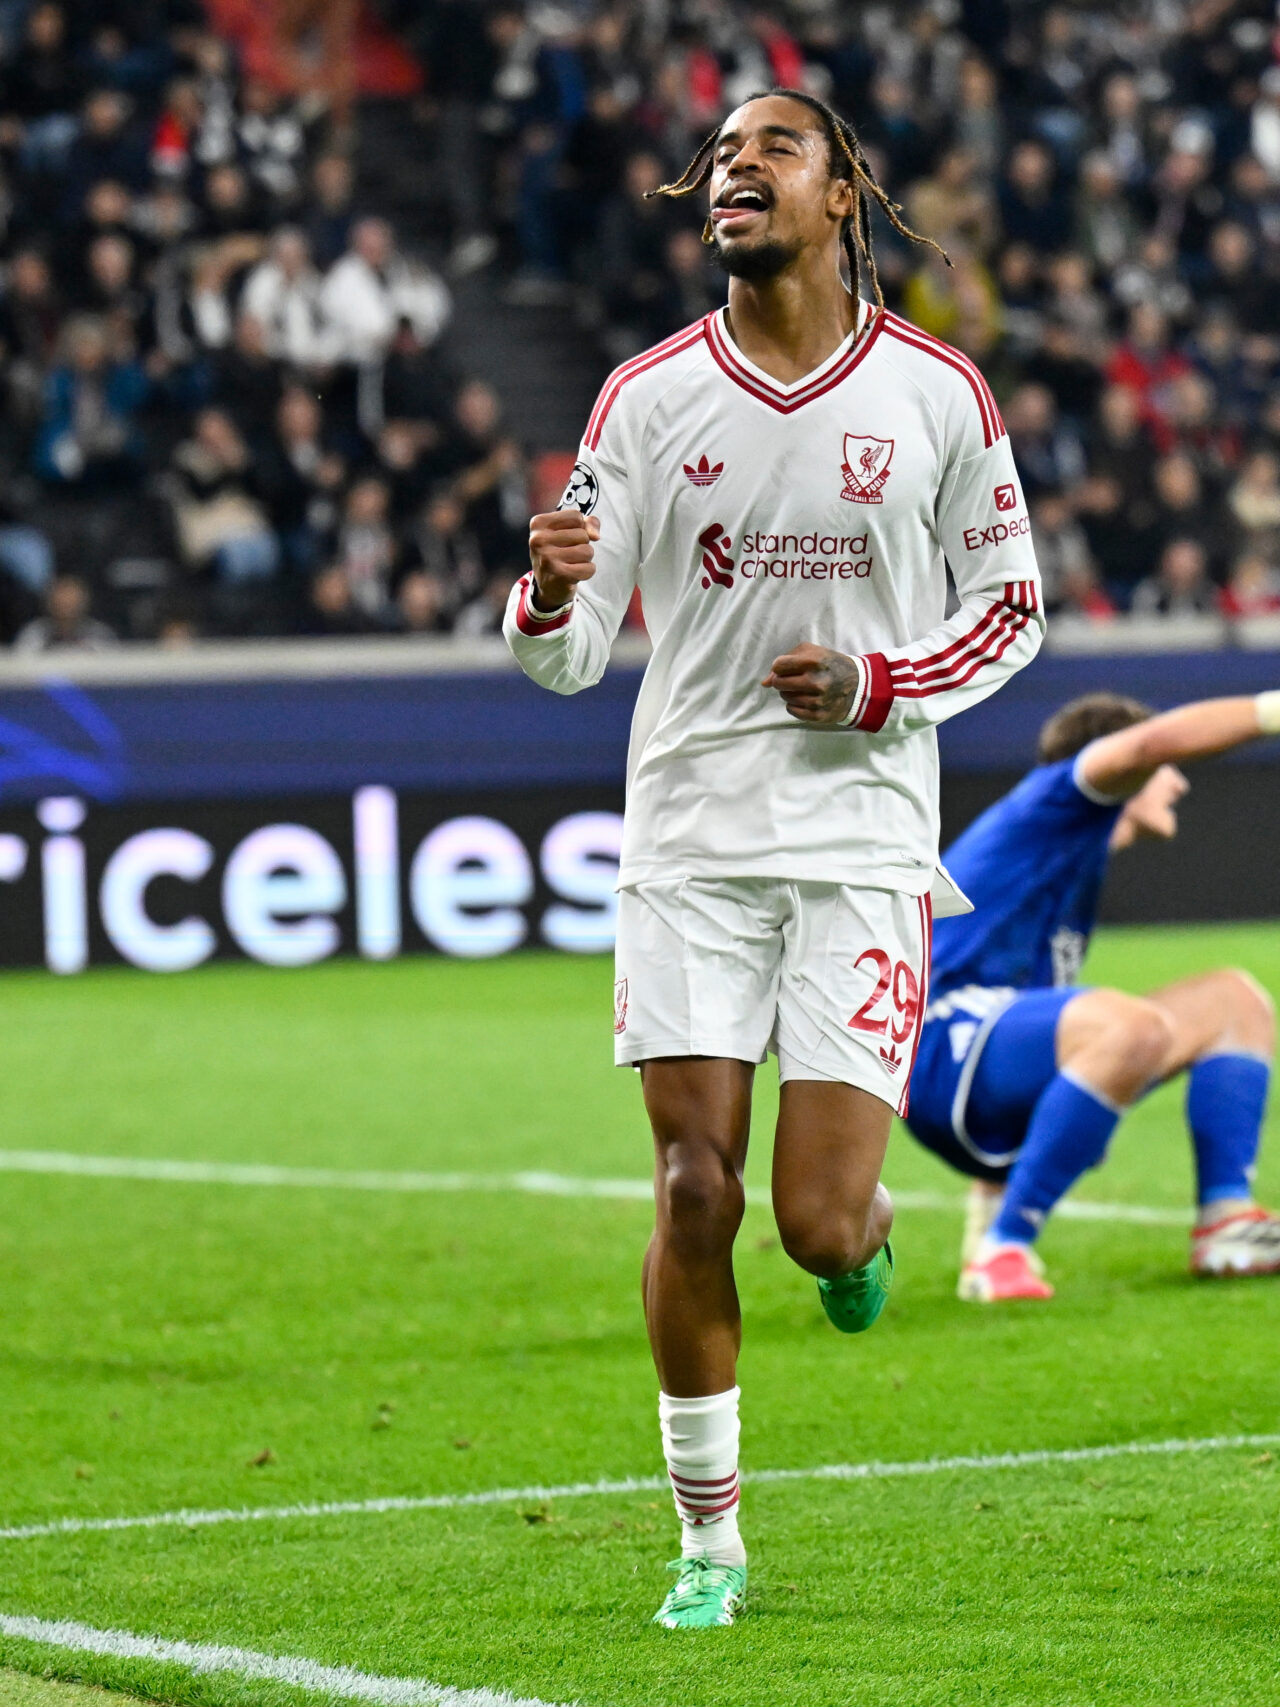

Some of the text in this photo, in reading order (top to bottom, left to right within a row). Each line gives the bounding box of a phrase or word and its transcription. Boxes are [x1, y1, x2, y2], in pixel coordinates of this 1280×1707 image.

[865, 477, 885, 495] POOL
[742, 530, 869, 555] standard
[741, 556, 873, 580] chartered
[847, 948, 919, 1044] 29
